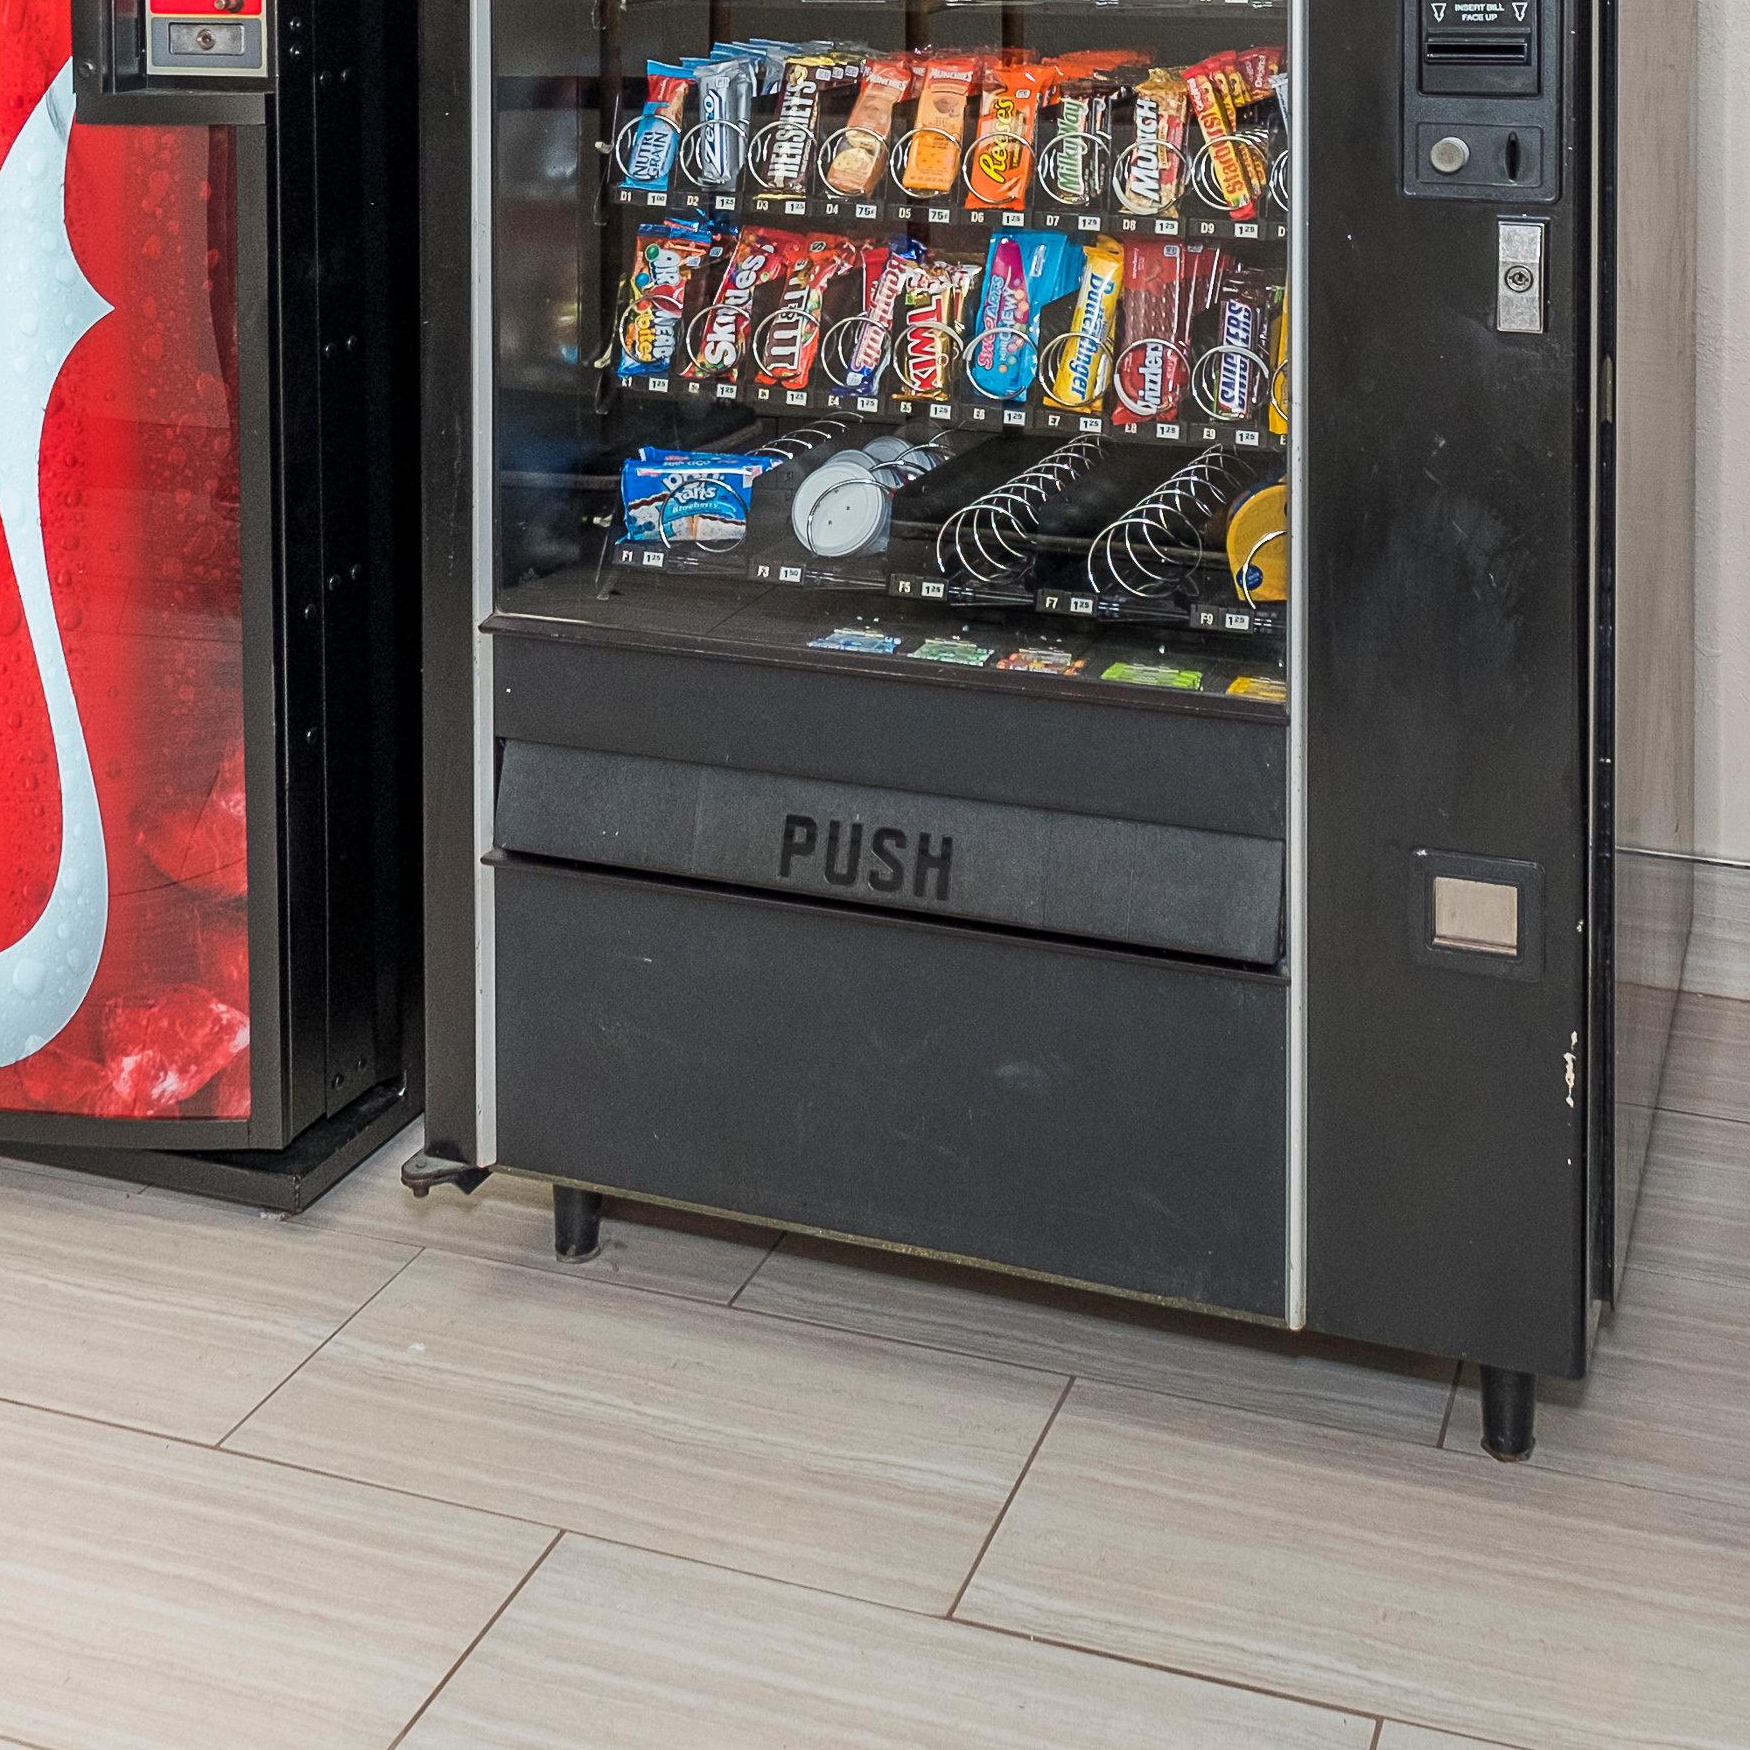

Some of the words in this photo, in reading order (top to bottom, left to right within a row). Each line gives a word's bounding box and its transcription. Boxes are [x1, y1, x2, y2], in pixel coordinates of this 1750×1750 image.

[1486, 3, 1504, 11] BILL
[767, 80, 817, 179] HERSHEY'S
[979, 98, 1014, 184] Reese's
[632, 131, 653, 178] NUTRI
[647, 131, 670, 180] GRAIN
[621, 192, 632, 202] D1
[687, 196, 699, 206] D2
[757, 201, 769, 210] D3
[826, 204, 839, 214] D4
[899, 208, 911, 218] D5
[971, 212, 984, 223] D6
[1046, 215, 1060, 226] D7
[1123, 219, 1136, 230] D8
[1201, 222, 1214, 233] D9
[1045, 597, 1057, 609] F7
[1201, 613, 1213, 624] F9
[779, 814, 953, 900] PUSH
